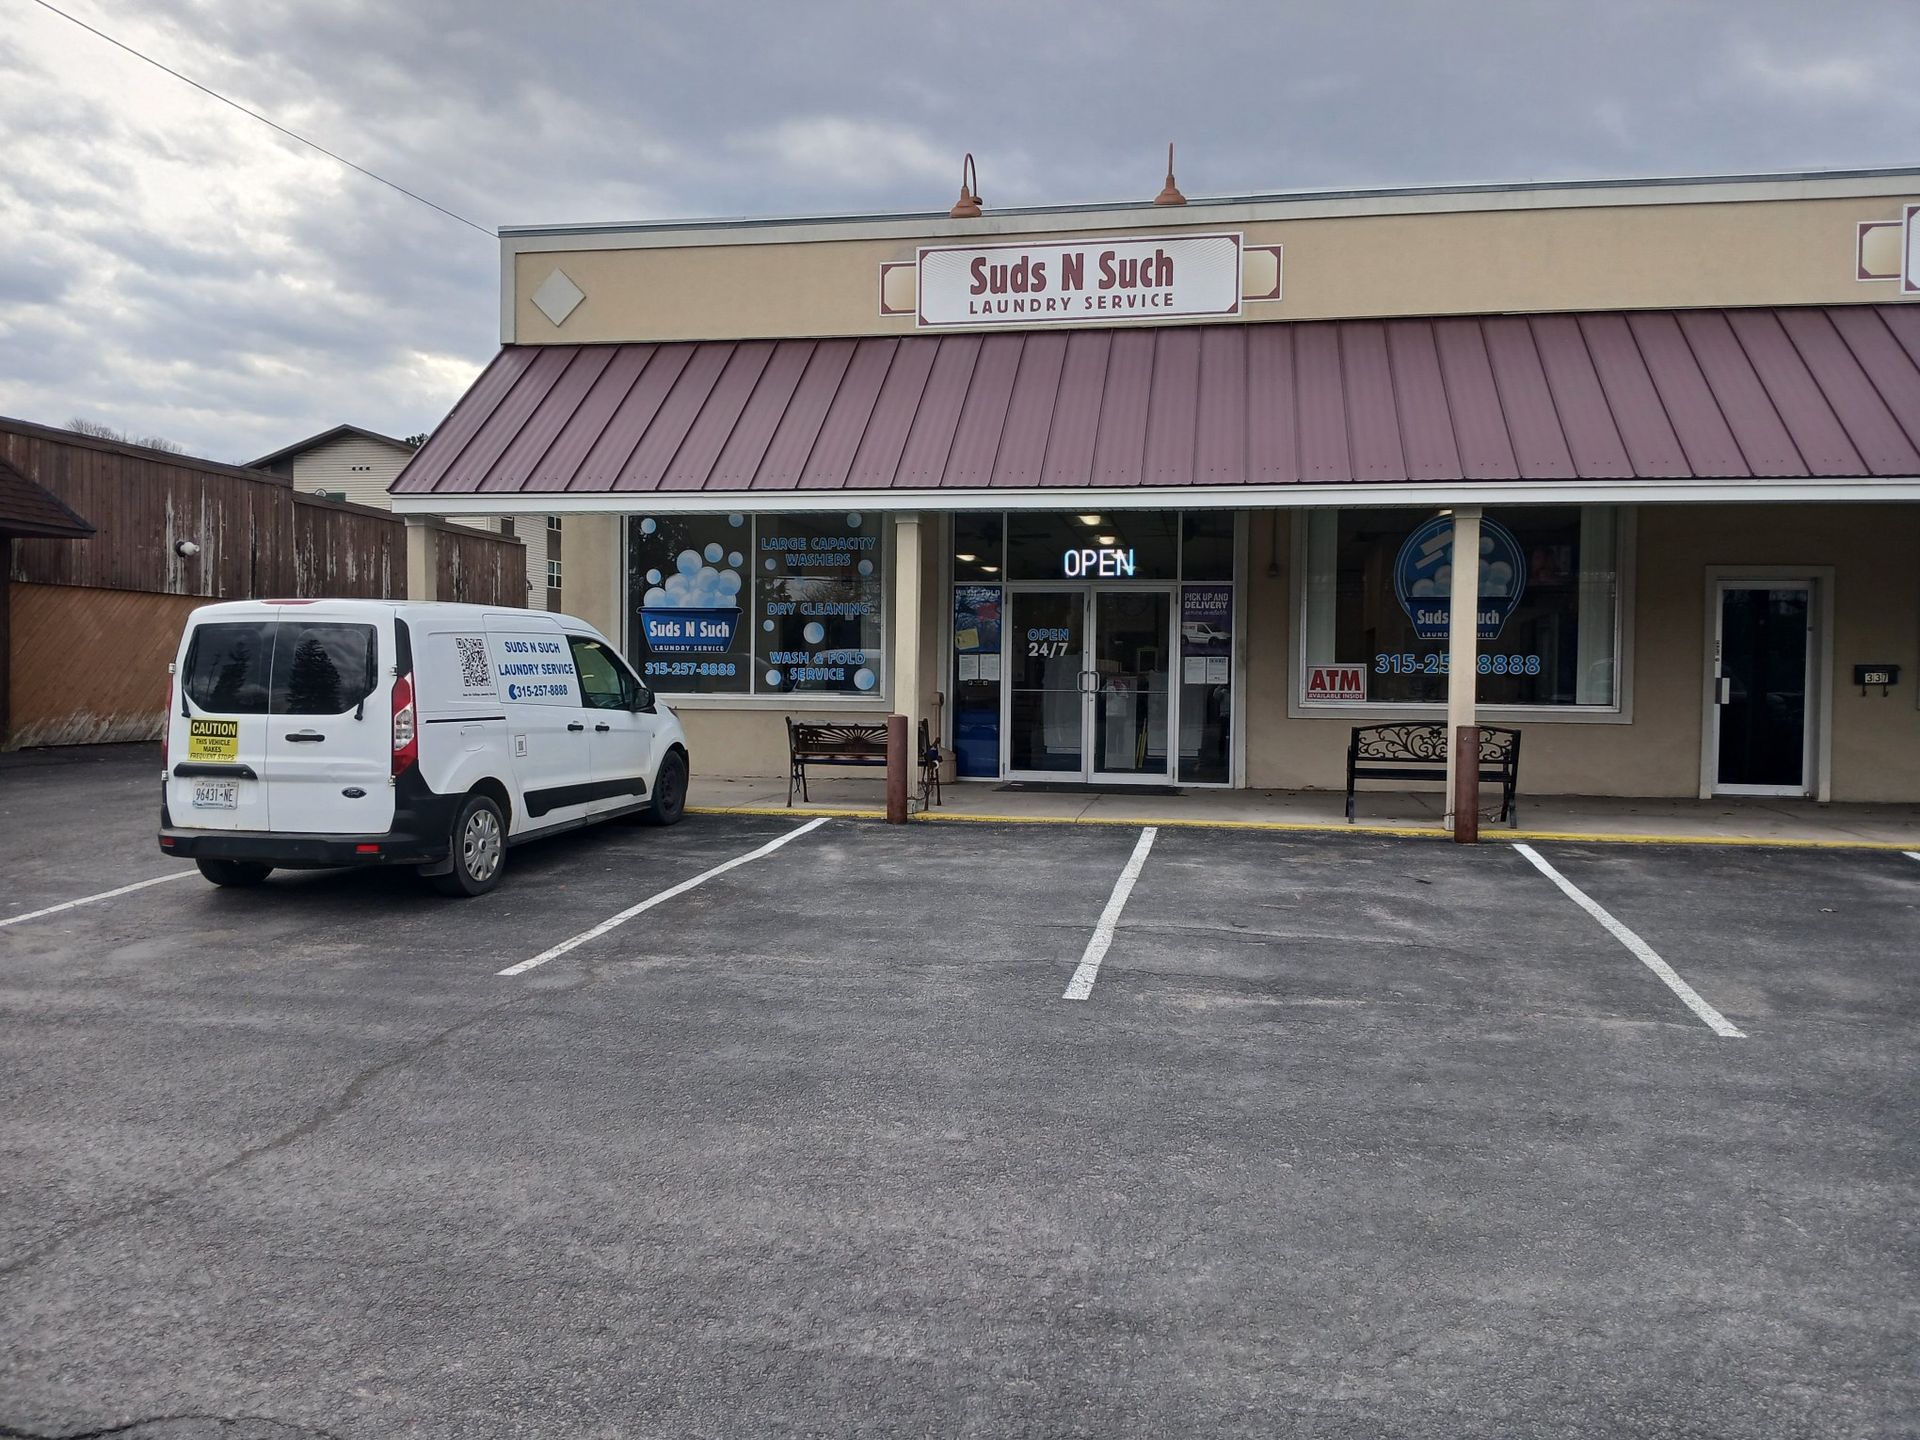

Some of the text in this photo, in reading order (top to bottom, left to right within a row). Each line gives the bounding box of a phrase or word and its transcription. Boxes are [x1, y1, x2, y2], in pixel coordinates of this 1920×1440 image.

[970, 249, 1175, 295] Suds N Such
[969, 292, 1175, 315] LAUNDRY SERVICE
[761, 537, 876, 550] LARGE CAPACITY
[785, 553, 851, 567] WASHERS
[1064, 548, 1134, 577] OPEN
[1184, 592, 1229, 602] PICK UP AND
[766, 602, 872, 616] DRY CLEANING
[1184, 601, 1228, 609] DELIVERY
[1416, 609, 1500, 625] Suds uch
[649, 620, 730, 638] Suds N Such
[1027, 628, 1069, 641] OPEN
[504, 641, 561, 654] SUDS N SUCH
[1028, 642, 1069, 659] 24/7
[769, 651, 866, 665] WASH & FOLD
[498, 663, 575, 676] LAUNDRY SERVICE
[644, 661, 736, 676] 315-257-8888
[789, 667, 845, 681] SERVICE
[1309, 669, 1361, 691] ATM
[1865, 673, 1888, 682] 337
[516, 684, 569, 698] 315-257-8888
[192, 722, 237, 736] CAUTION
[203, 745, 222, 753] MAKES
[208, 738, 231, 746] VEHICLE
[189, 752, 235, 761] FREQUENT STOPS
